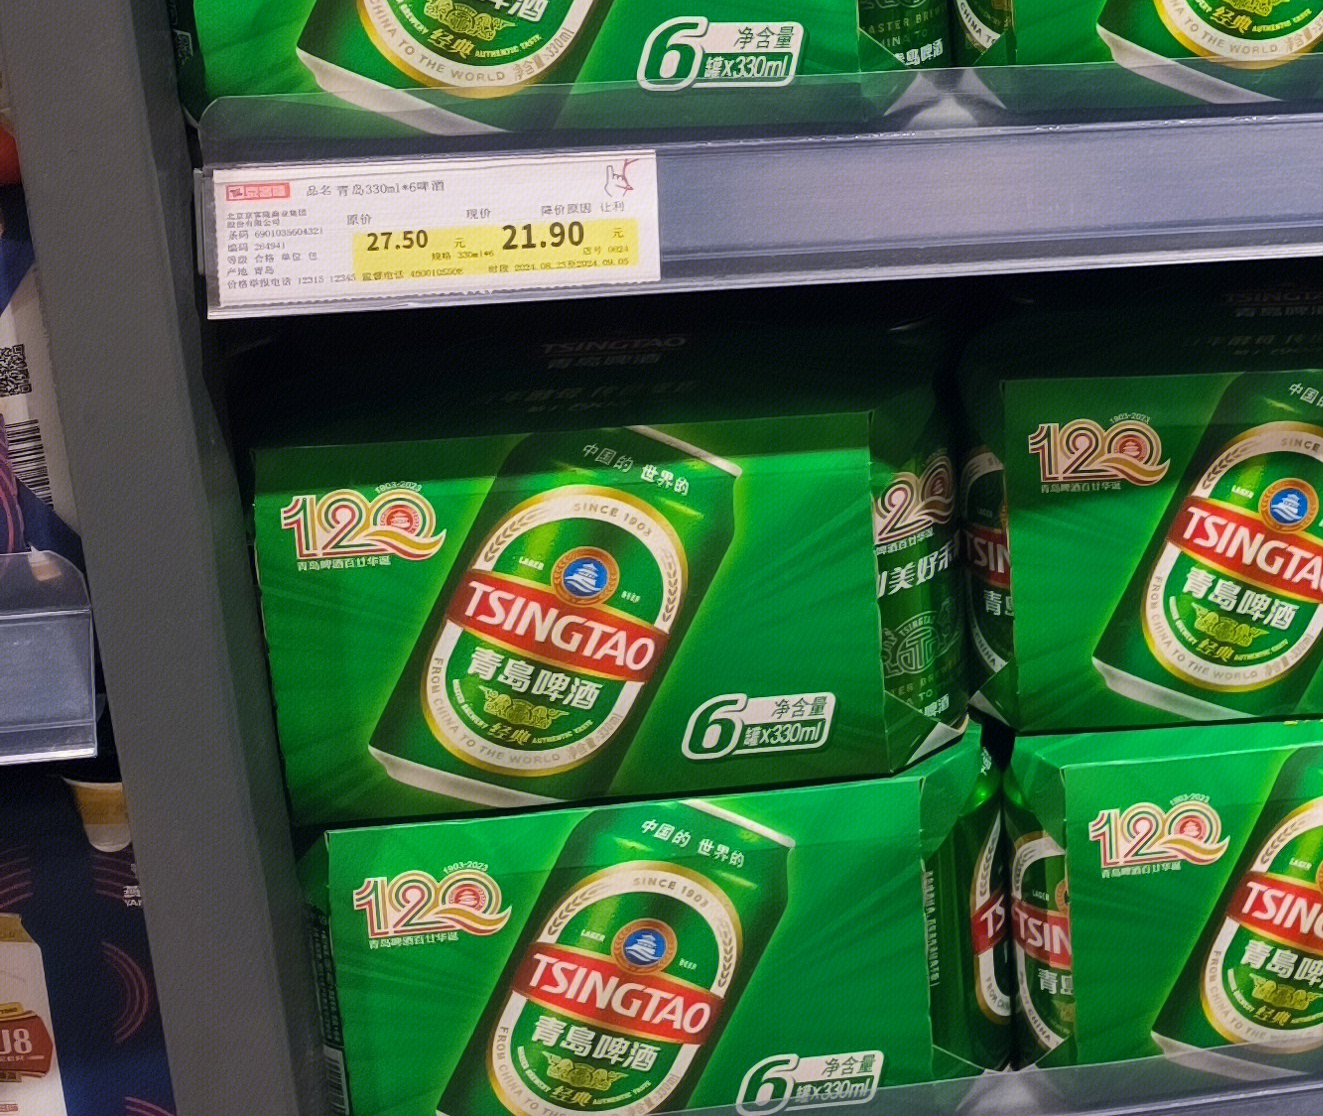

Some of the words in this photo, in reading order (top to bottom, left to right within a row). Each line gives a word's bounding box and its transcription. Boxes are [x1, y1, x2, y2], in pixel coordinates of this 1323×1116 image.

[637, 17, 709, 91] 6
[307, 184, 331, 196] 品名
[347, 214, 372, 226] 原价
[466, 208, 491, 219] 现价
[541, 202, 591, 216] 降价原因
[600, 201, 625, 213] 让利
[367, 230, 428, 252] 27.50
[454, 238, 465, 249] 元
[502, 221, 584, 251] 21.90
[613, 228, 624, 238] 元
[298, 275, 325, 285] 12315
[464, 579, 655, 673] TSINGTAO
[466, 646, 602, 710] 青島啤酒
[682, 695, 748, 759] 6
[530, 953, 711, 1034] TSINGTAO
[532, 1016, 661, 1073] 青島啤酒
